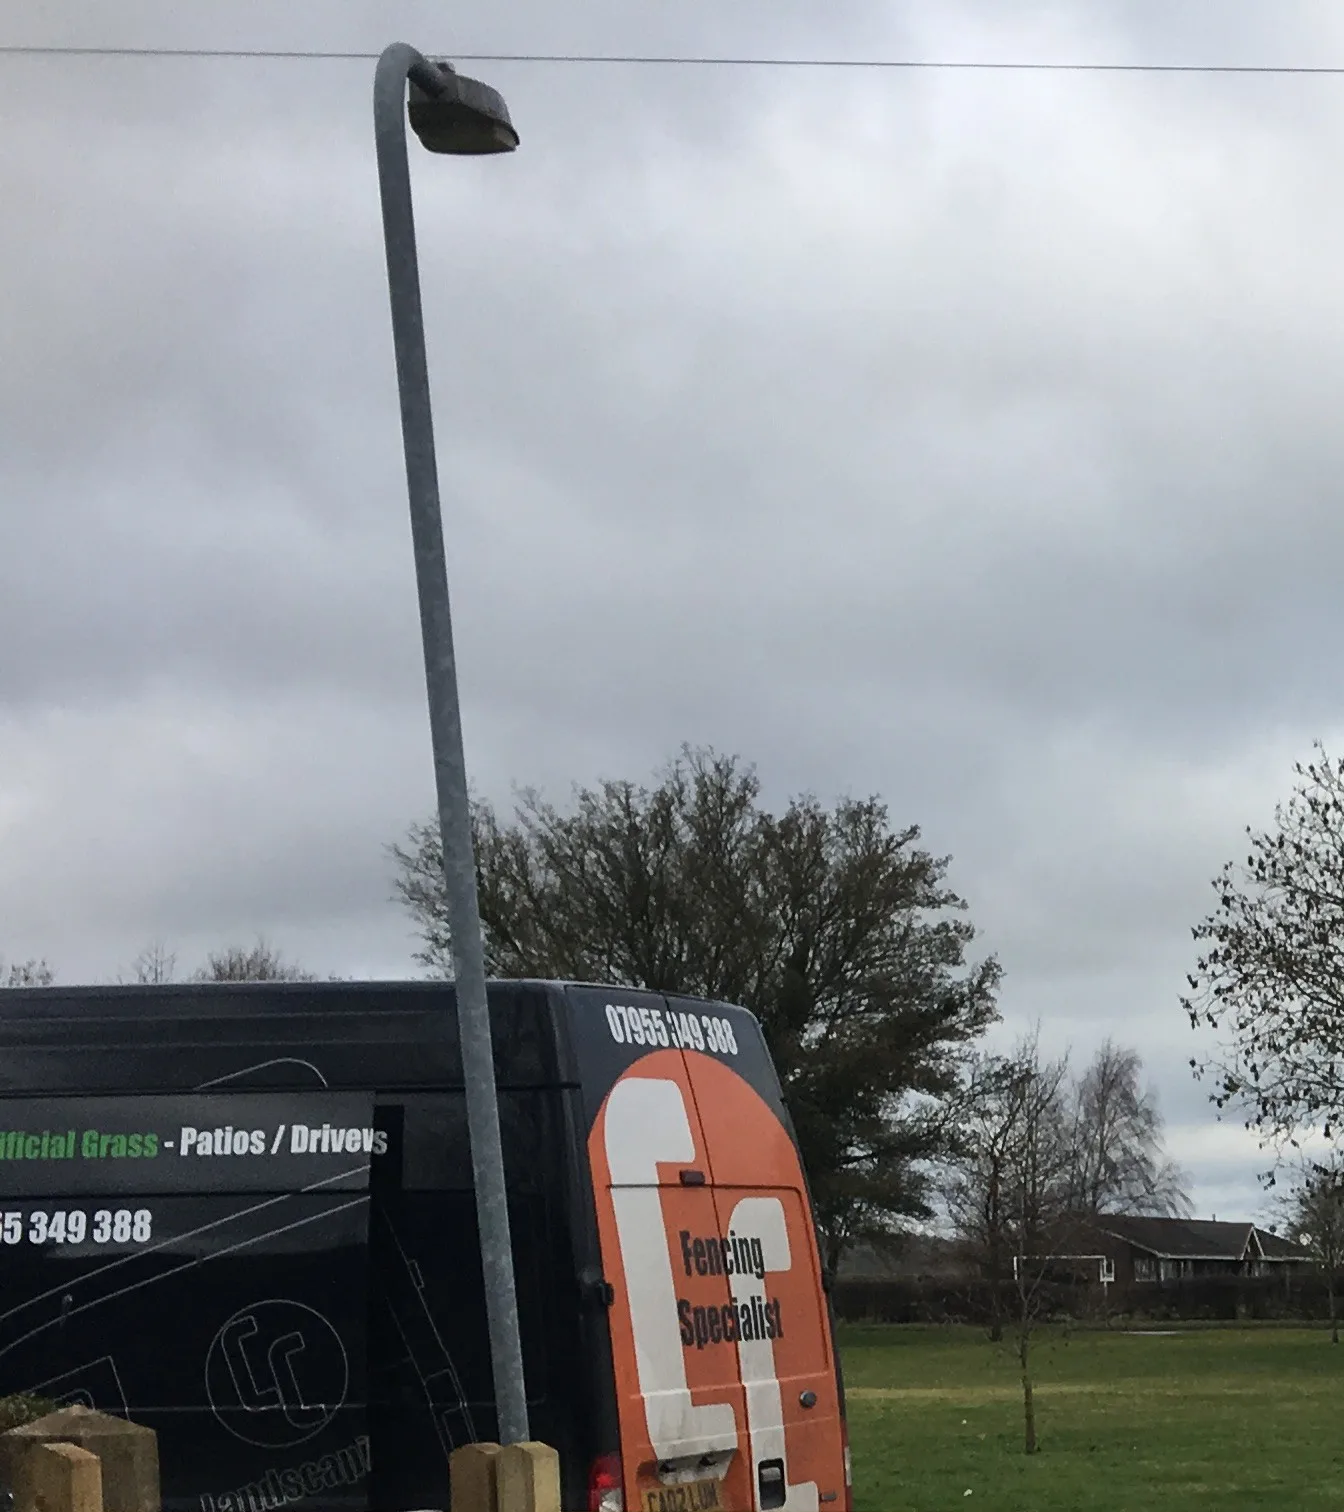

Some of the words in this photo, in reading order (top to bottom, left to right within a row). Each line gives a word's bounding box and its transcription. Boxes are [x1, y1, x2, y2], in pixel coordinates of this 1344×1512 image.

[605, 1004, 669, 1047] 07955
[665, 1011, 705, 1051] 349
[701, 1015, 738, 1055] 388
[81, 1129, 159, 1159] Grass
[164, 1141, 174, 1149] -
[179, 1125, 266, 1156] Patios
[270, 1124, 286, 1155] /
[28, 1210, 87, 1244] 349
[93, 1209, 153, 1243] 388
[679, 1230, 765, 1279] Fencing
[677, 1295, 784, 1350] Specialist
